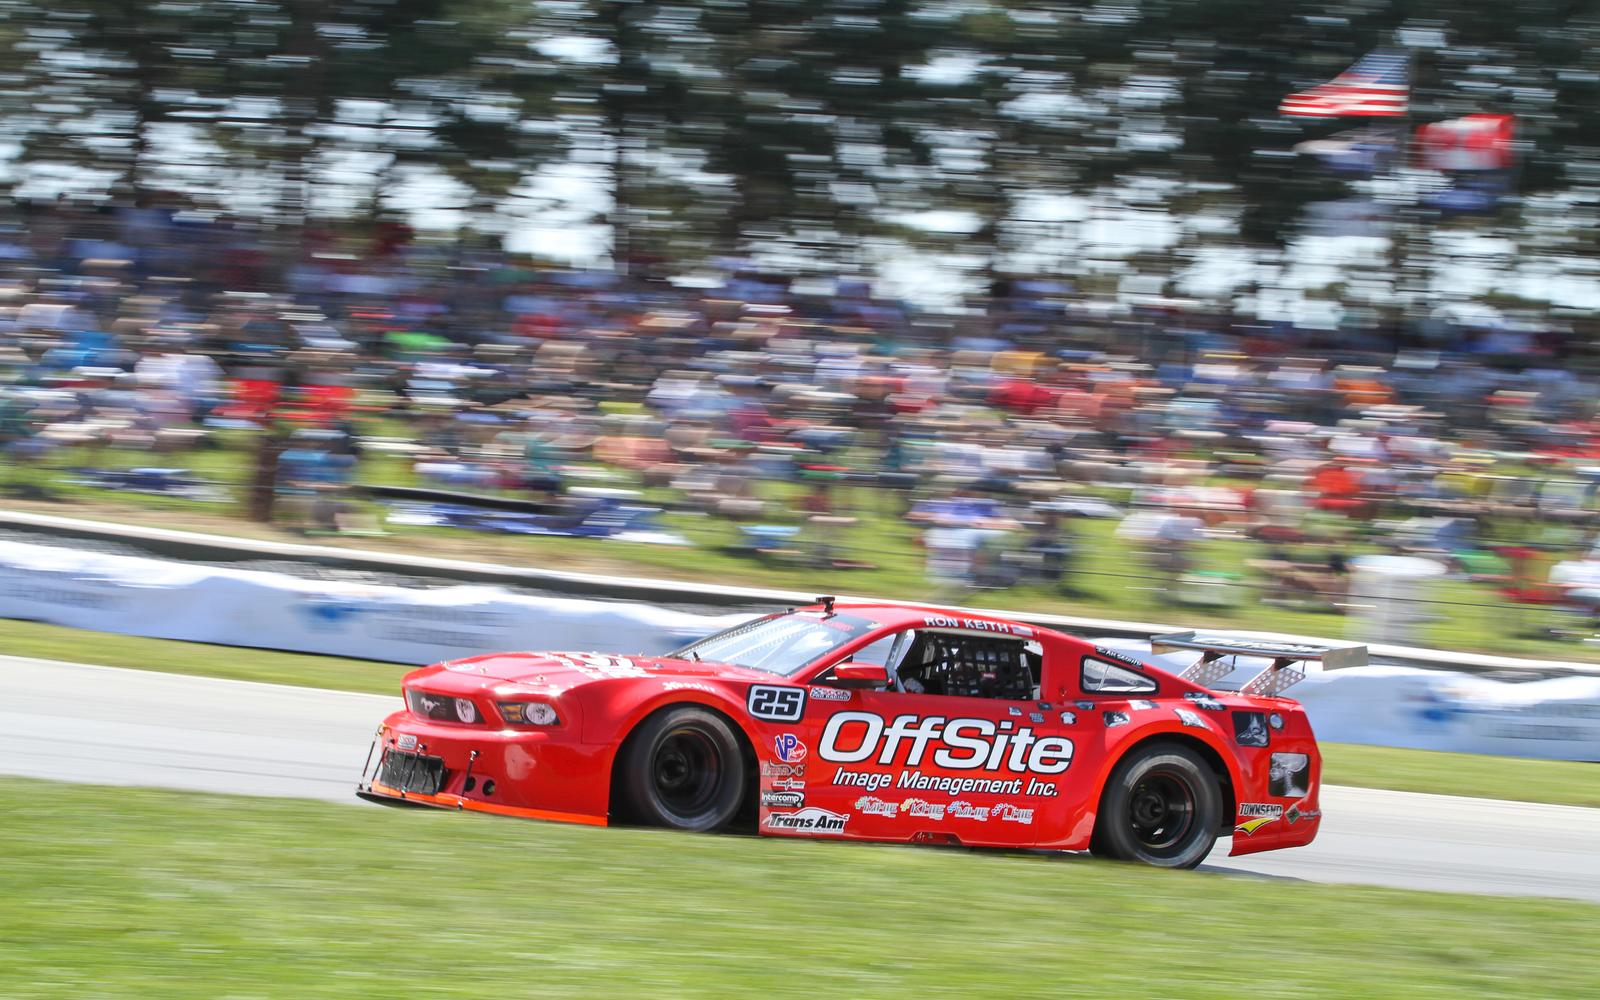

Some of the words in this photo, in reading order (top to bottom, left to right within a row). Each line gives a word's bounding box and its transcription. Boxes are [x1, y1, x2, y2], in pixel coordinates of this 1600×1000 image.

[924, 617, 959, 628] RON
[964, 618, 1009, 633] KEITH
[753, 689, 800, 715] 25
[775, 734, 797, 761] VP
[819, 712, 1074, 774] OffSite
[833, 768, 892, 788] Image
[897, 771, 1023, 796] Management
[1025, 778, 1059, 797] Inc.
[761, 791, 799, 804] Intercomp
[769, 813, 814, 828] Trans
[814, 816, 845, 829] Am
[1240, 804, 1283, 817] TOWNSEND
